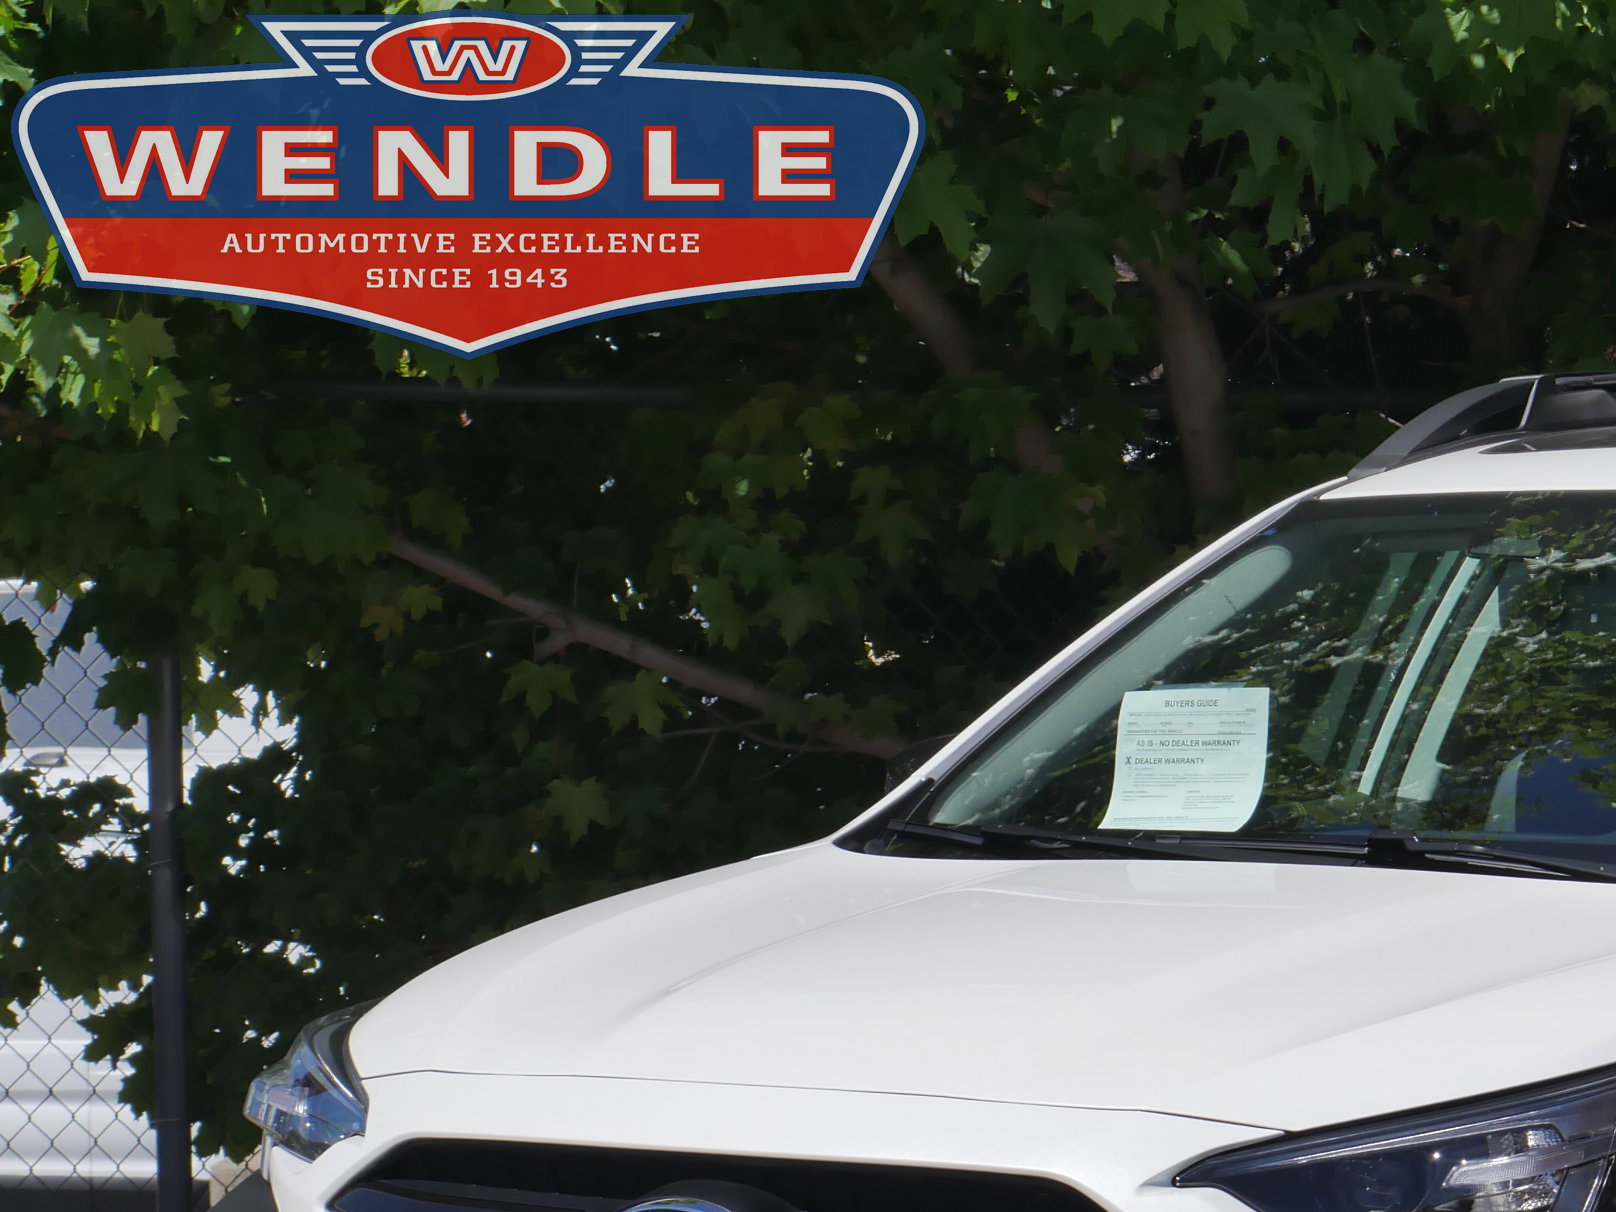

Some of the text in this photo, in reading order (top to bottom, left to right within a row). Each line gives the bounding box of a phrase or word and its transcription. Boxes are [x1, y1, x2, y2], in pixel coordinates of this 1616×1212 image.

[1164, 699, 1219, 708] BUYERS GUIDE
[1136, 739, 1146, 747] AS
[1147, 739, 1154, 747] IS
[1159, 739, 1171, 747] NO
[1172, 739, 1200, 747] DEALER
[1201, 739, 1241, 747] WARRANTY
[1134, 757, 1163, 765] DEALER
[1164, 757, 1206, 765] WARRANTY
